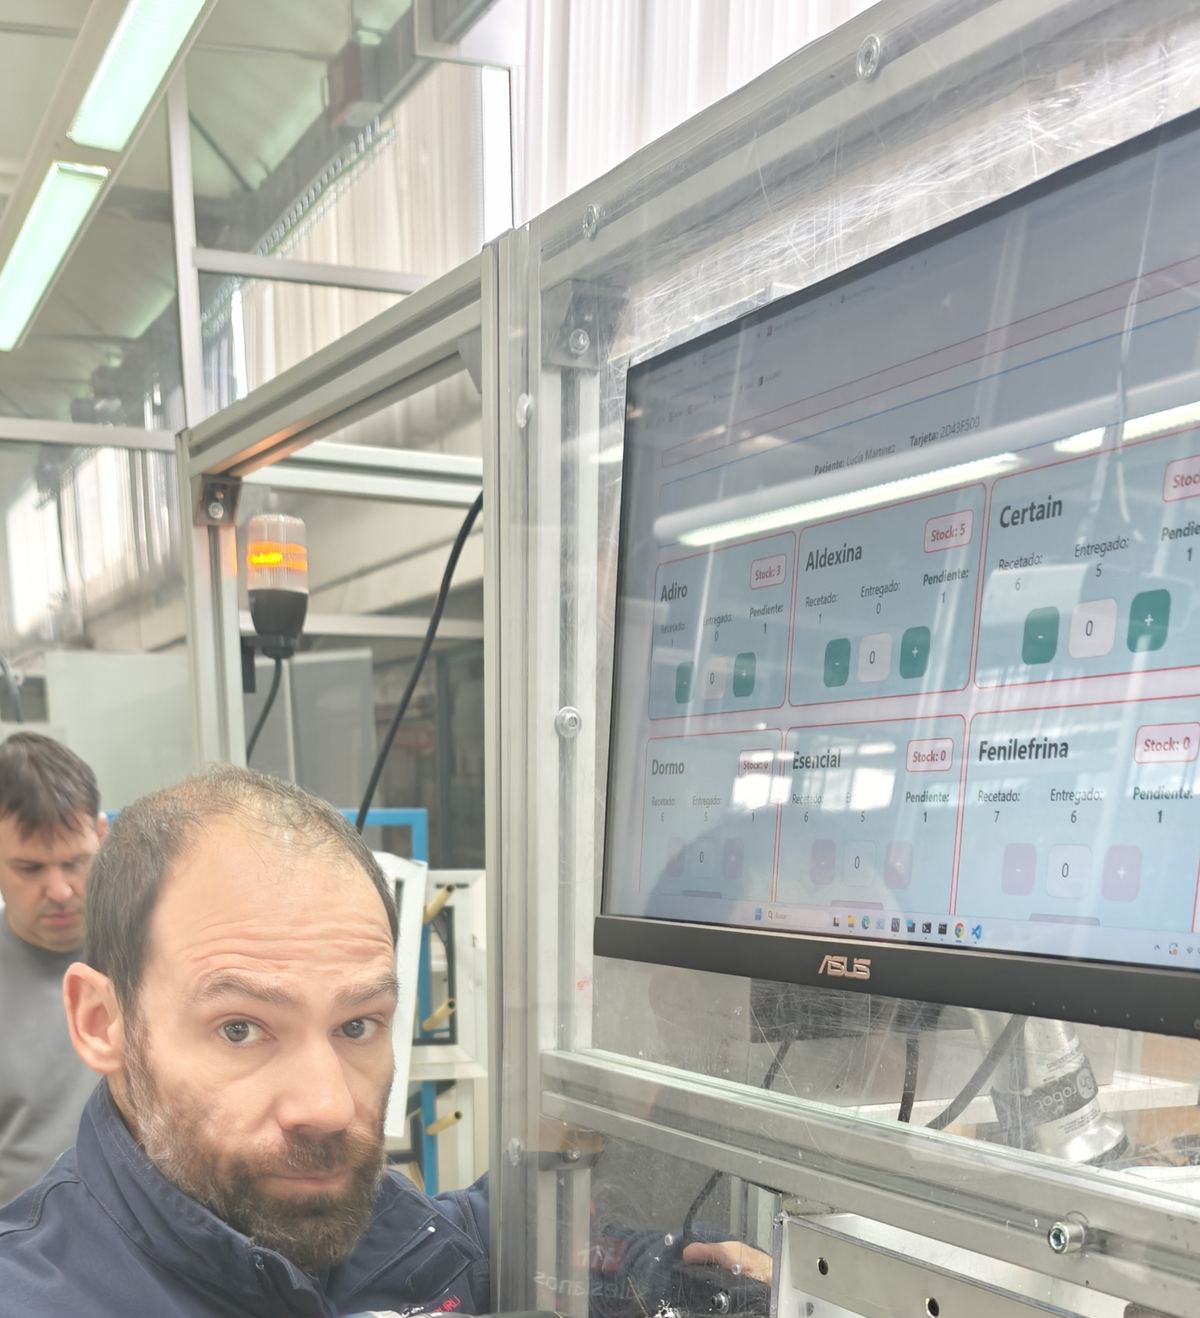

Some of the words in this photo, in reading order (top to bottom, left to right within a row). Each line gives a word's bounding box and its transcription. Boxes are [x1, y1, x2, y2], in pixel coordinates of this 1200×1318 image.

[910, 430, 939, 447] Tarjeta:
[814, 459, 844, 475] Paciente:
[1173, 473, 1200, 489] Stoc
[1000, 495, 1063, 528] Certain
[931, 526, 958, 542] Stock:
[959, 523, 965, 536] 5
[1161, 521, 1200, 542] Pendie
[1075, 537, 1129, 559] Entregado:
[1187, 548, 1192, 561] 1
[806, 543, 862, 572] Aldexina
[999, 552, 1042, 570] Recetado:
[755, 567, 775, 581] Stock:
[923, 568, 969, 586] Pendiente:
[1096, 563, 1102, 577] 5
[661, 581, 688, 602] Adiro
[861, 579, 900, 598] Entregado:
[1015, 578, 1021, 591] 6
[805, 592, 838, 608] Recetado:
[750, 604, 784, 618] Pendiente:
[876, 602, 882, 615] 0
[1085, 620, 1094, 636] 0
[869, 650, 876, 664] 0
[709, 672, 715, 685] 0
[978, 737, 1069, 762] Fenilefrina
[1143, 737, 1179, 752] Stock:
[1183, 736, 1190, 750] 0
[792, 749, 841, 770] Esencial
[912, 753, 938, 763] Stock:
[940, 751, 946, 762] 0
[651, 759, 685, 776] Dormo
[906, 791, 949, 803] Pendiente:
[978, 789, 1020, 802] Recetado:
[1050, 787, 1103, 805] Entregado:
[1133, 786, 1193, 800] Pendiente:
[804, 811, 809, 823] 6
[860, 811, 865, 822] 5
[994, 811, 1000, 823] 7
[1070, 810, 1077, 823] 6
[1157, 810, 1163, 823] 1
[854, 856, 860, 869] 0
[1061, 862, 1069, 878] 0
[818, 955, 871, 980] ASUS
